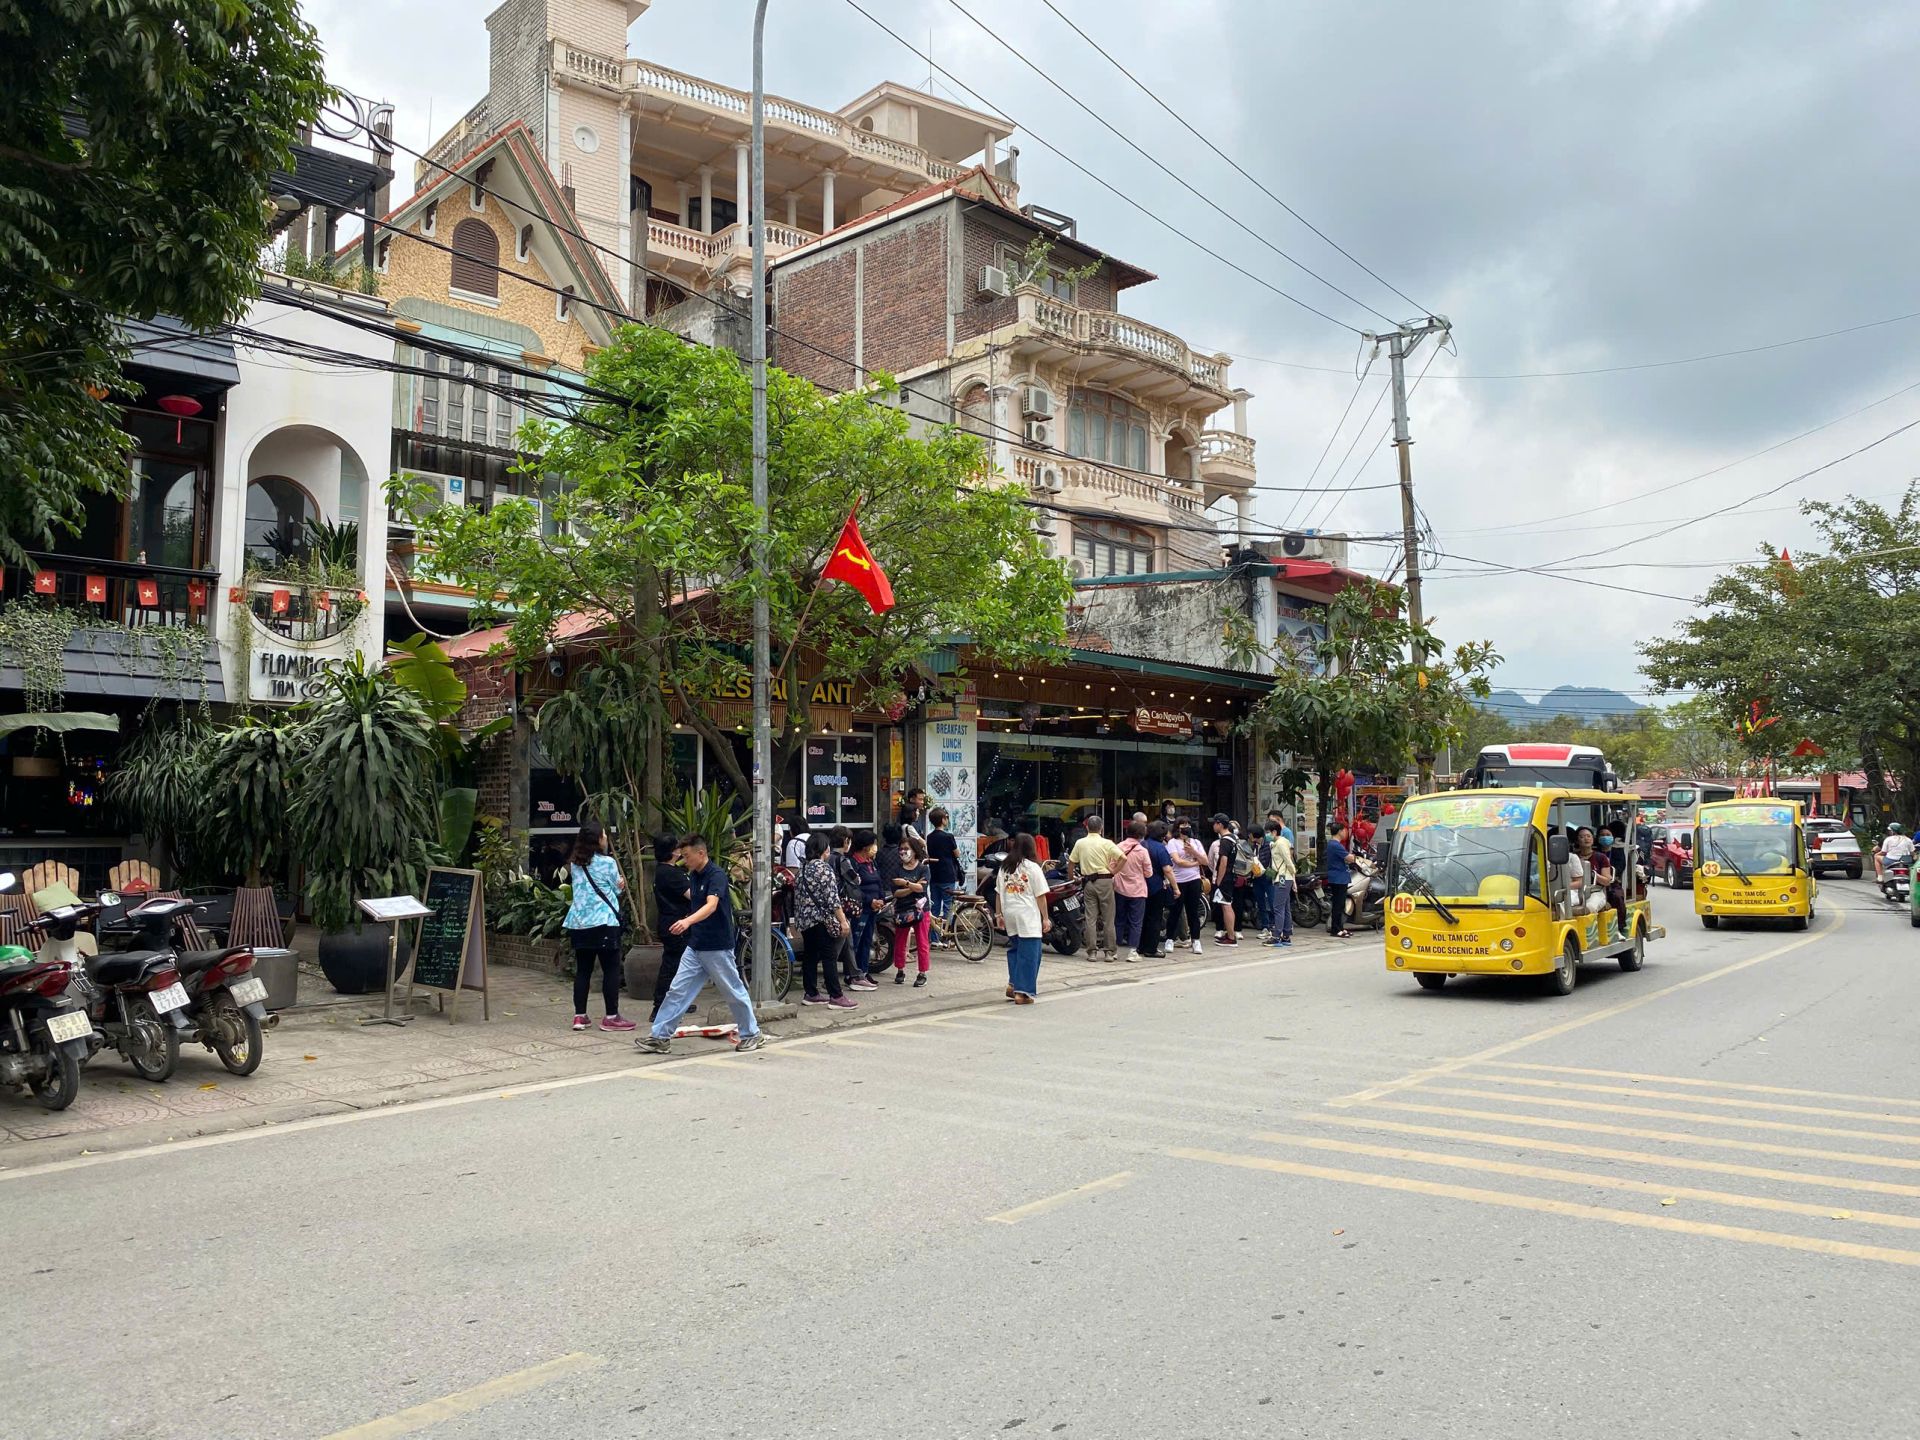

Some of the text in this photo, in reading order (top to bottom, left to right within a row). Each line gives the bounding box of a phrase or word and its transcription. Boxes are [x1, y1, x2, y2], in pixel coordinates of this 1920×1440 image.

[271, 680, 295, 697] TAM
[936, 723, 968, 735] BREAKFAST
[943, 738, 962, 748] LUNCH
[941, 751, 962, 762] DINNER
[537, 801, 555, 811] Xin
[1704, 863, 1718, 875] 33
[1394, 897, 1412, 913] 06
[1432, 934, 1446, 942] KDL
[1448, 934, 1463, 942] TAM
[1417, 945, 1431, 953] TAM
[1433, 946, 1446, 954] COC
[1447, 946, 1473, 954] SCENIC
